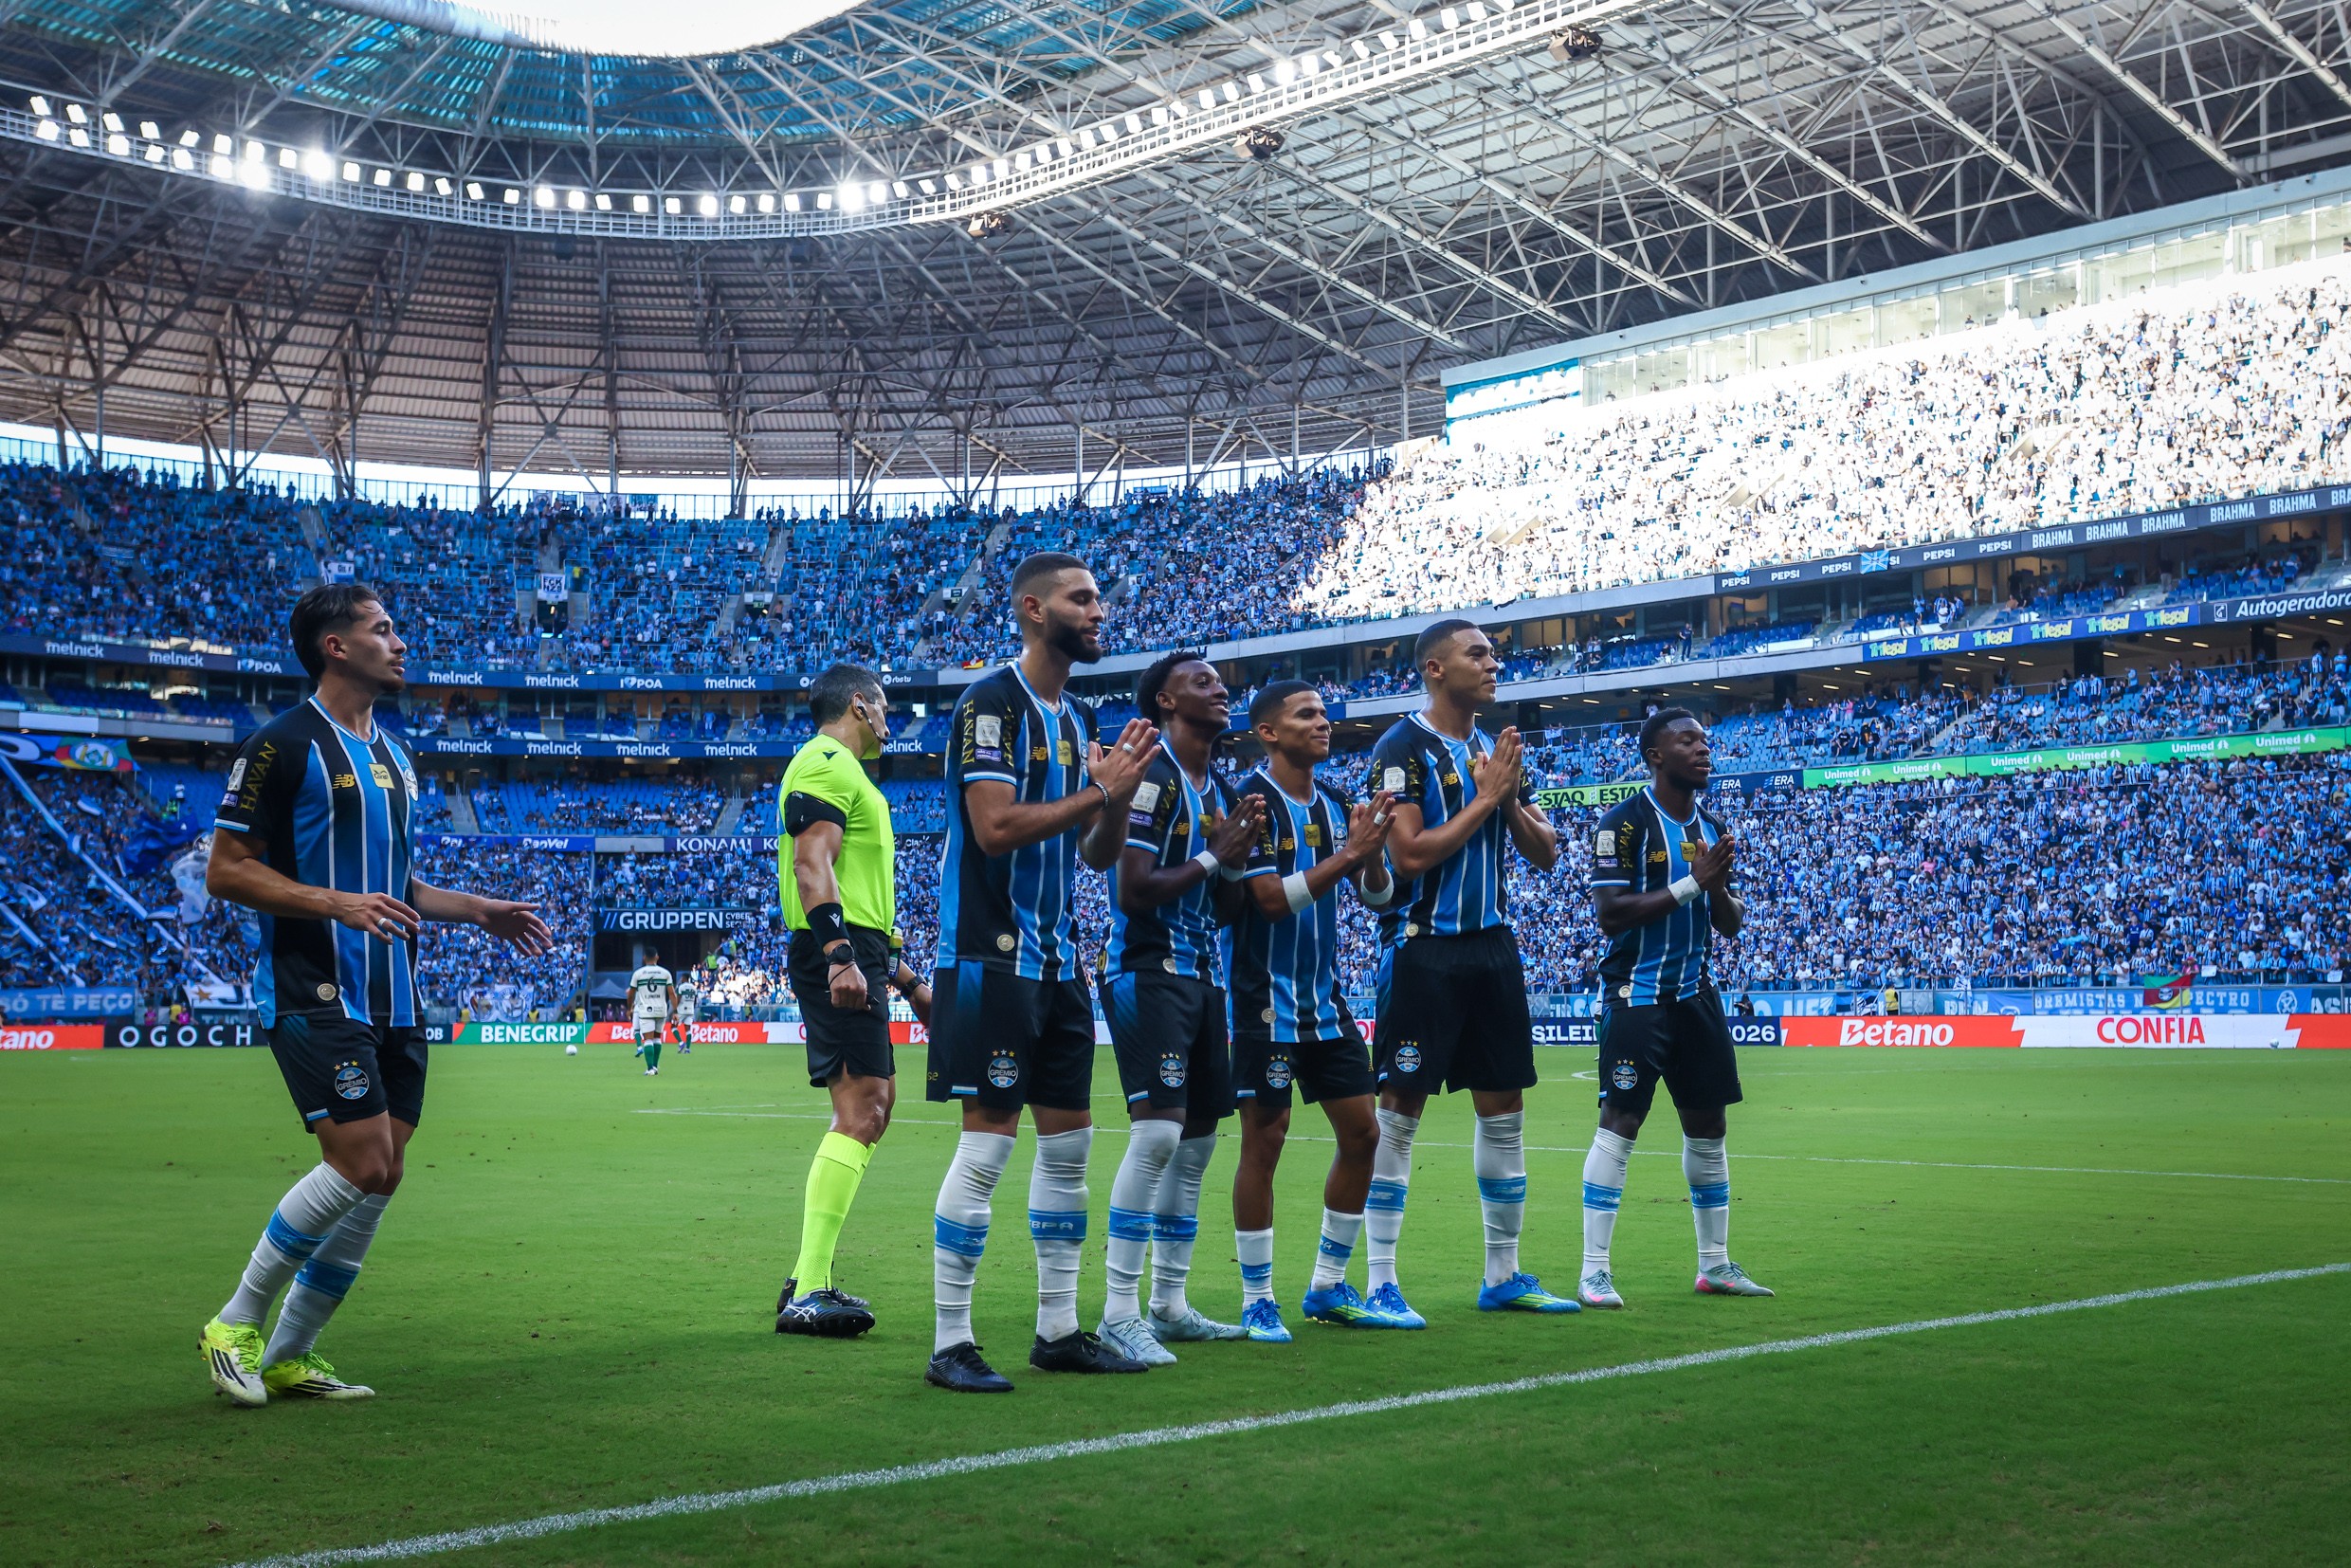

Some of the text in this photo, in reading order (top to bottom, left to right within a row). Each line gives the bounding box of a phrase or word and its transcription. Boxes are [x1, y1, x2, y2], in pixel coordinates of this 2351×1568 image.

[2032, 529, 2073, 549] BRAHMA
[2086, 521, 2128, 541] BRAHMA
[2141, 513, 2186, 533] BRAHMA
[2210, 502, 2255, 522] BRAHMA
[2269, 493, 2317, 515] BRAHMA
[1722, 539, 2012, 588] PEPSI PEPSI PEPSI PEPSI PEPSI
[45, 641, 204, 667] melnick melnick
[252, 661, 282, 674] POA
[428, 670, 579, 688] melnick melnick
[637, 677, 663, 689] POA
[704, 676, 756, 689] melnick
[436, 739, 757, 757] melnick melnick melnick melnick
[2171, 740, 2214, 754] Unimed
[2255, 735, 2301, 747] Unimed
[1991, 754, 2030, 767] Unimed
[2067, 750, 2107, 761] Unimed
[240, 740, 279, 813] HAVAN
[1824, 769, 1860, 780] Unimed
[1893, 763, 1929, 775] Unimed
[1722, 775, 1795, 790] ERA ERA
[676, 838, 752, 852] KONAMI
[619, 912, 723, 930] GRUPPEN
[647, 976, 658, 994] 6
[35, 994, 66, 1012] TE
[73, 993, 133, 1014] PEÇO
[2034, 993, 2125, 1009] GREMISTAS
[481, 1024, 579, 1043] BENEGRIP
[690, 1024, 738, 1043] Betano
[1531, 1025, 1598, 1042] SILEI
[1839, 1019, 1955, 1047] Betano
[2096, 1017, 2206, 1044] CONFIA
[1030, 1220, 1074, 1231] BPA
